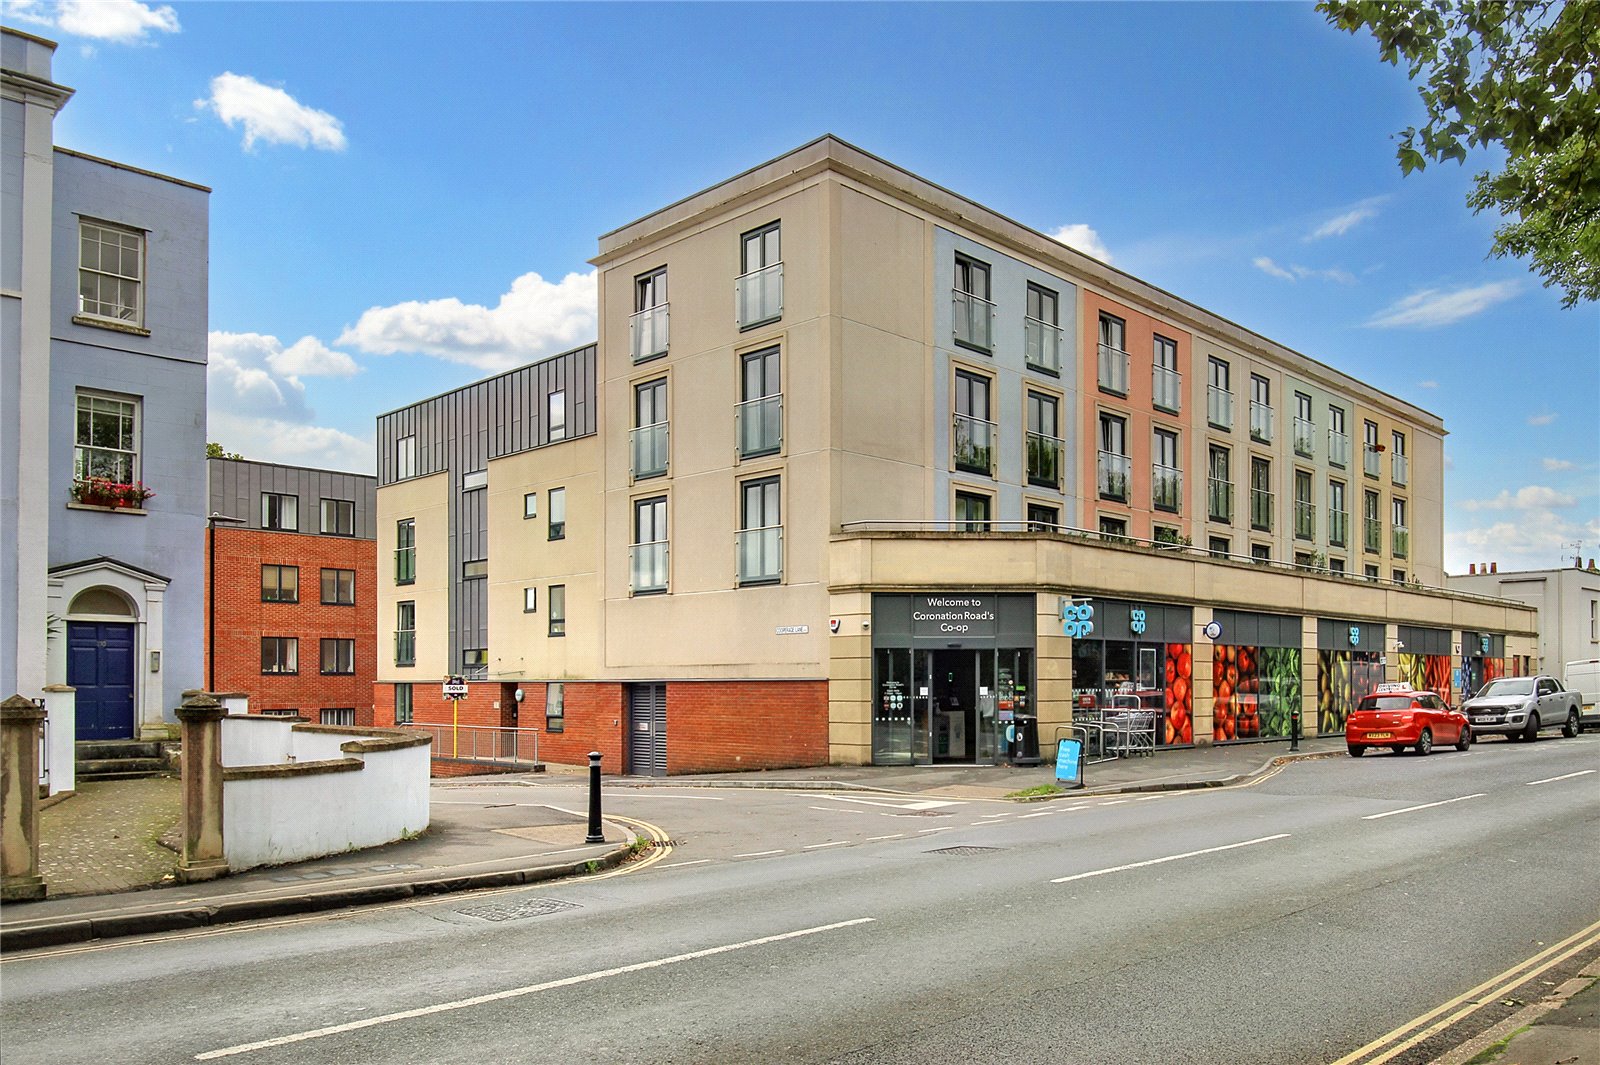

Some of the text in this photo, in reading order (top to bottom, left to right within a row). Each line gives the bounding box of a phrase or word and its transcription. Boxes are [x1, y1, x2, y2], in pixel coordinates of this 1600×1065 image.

[927, 598, 981, 607] Welcome to
[913, 611, 995, 621] Coronation Road's
[940, 623, 969, 633] Co-op
